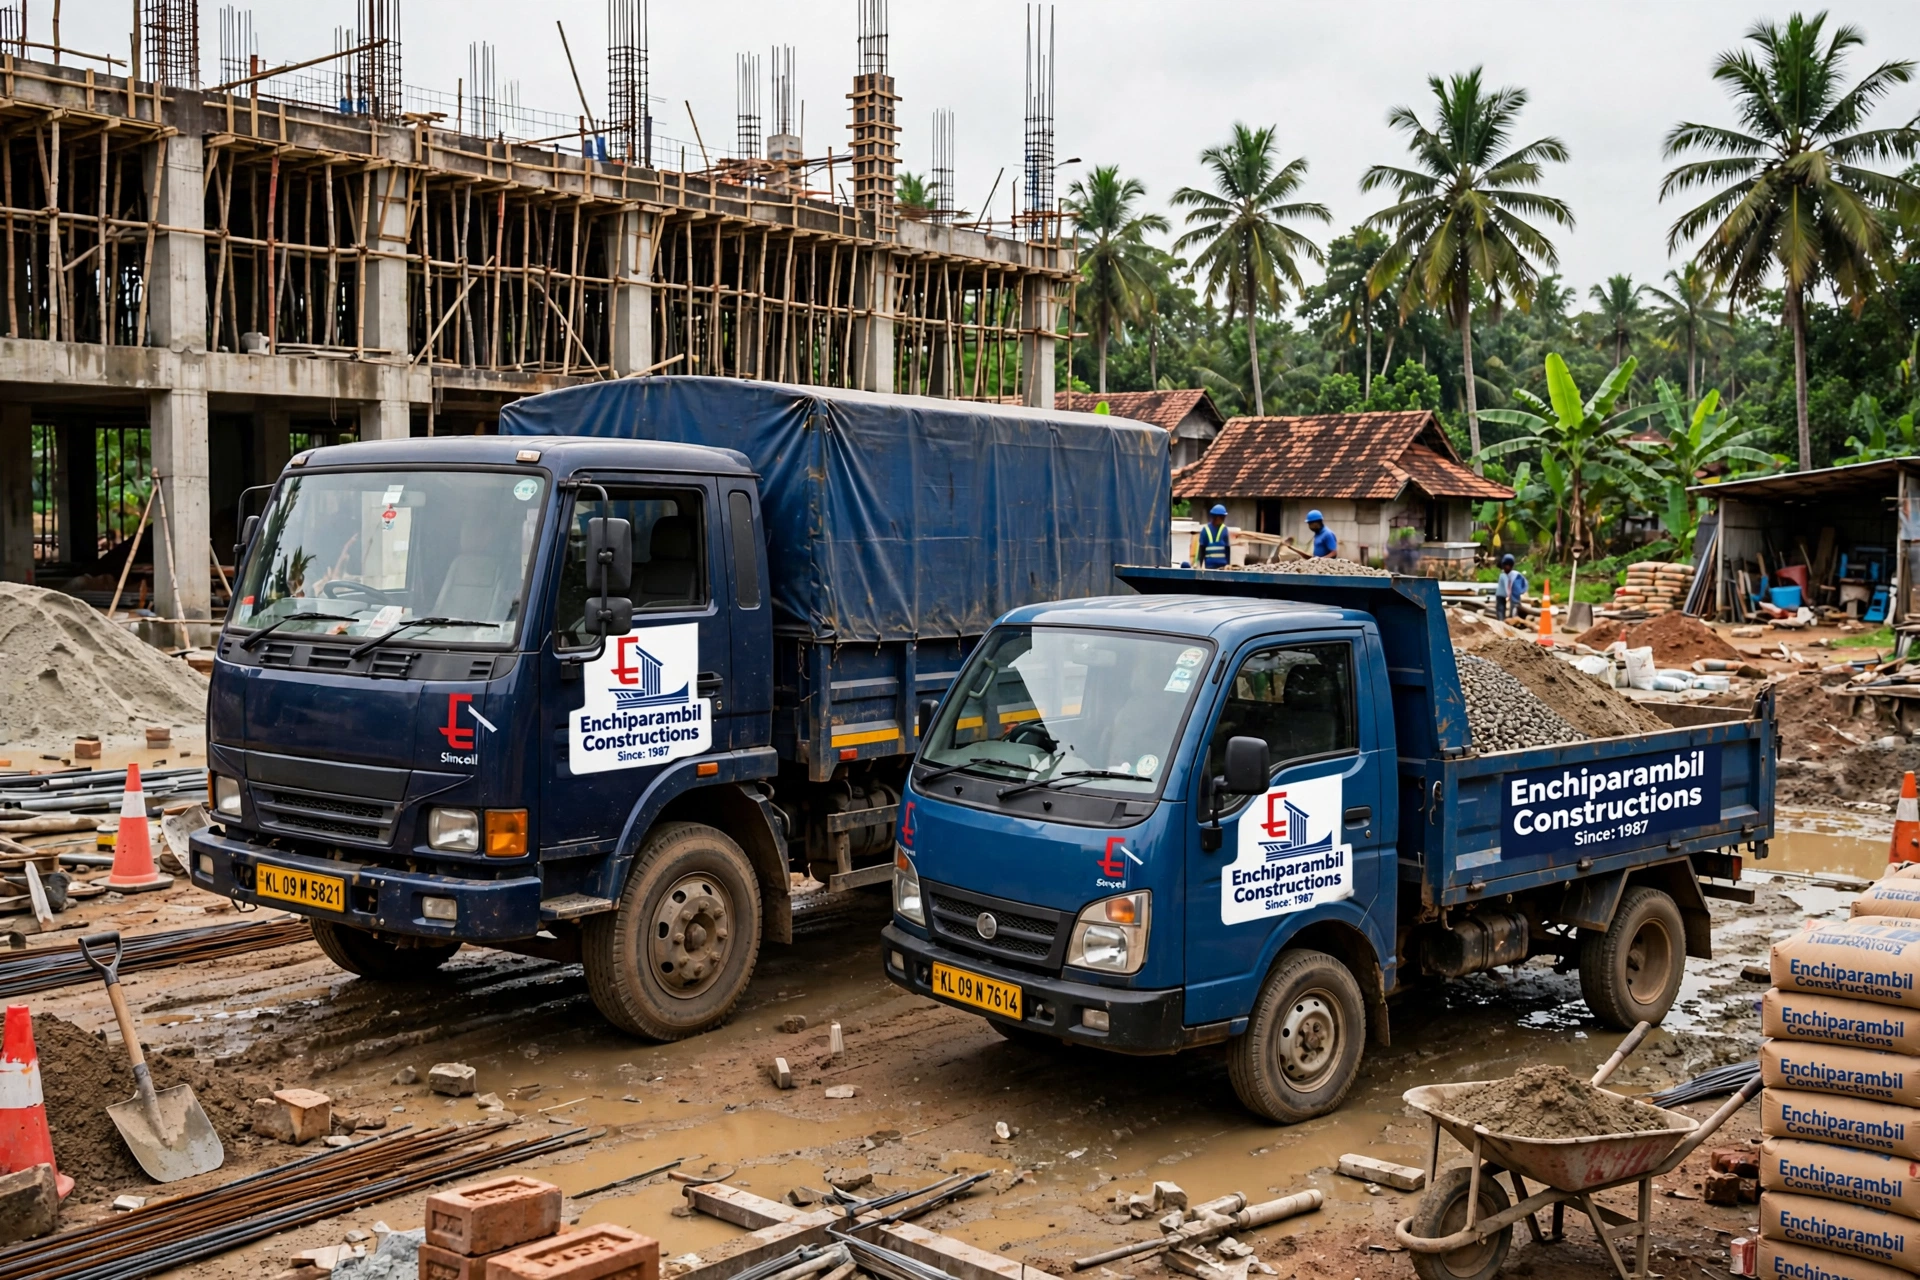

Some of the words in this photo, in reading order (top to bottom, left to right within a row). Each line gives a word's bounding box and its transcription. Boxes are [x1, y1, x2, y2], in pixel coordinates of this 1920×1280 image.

[580, 704, 701, 733] Enchiparambil
[583, 727, 699, 751] Constructions
[617, 750, 645, 761] Since:
[648, 746, 670, 757] 1987
[1511, 750, 1704, 806] Enchiparambil
[1513, 787, 1703, 836] Constructions
[1574, 829, 1616, 846] Since:
[1617, 819, 1649, 838] 1987
[1232, 851, 1344, 886] Enchiparambil
[265, 871, 279, 893] KL
[283, 875, 297, 896] 09
[311, 880, 340, 905] 5821
[1234, 873, 1342, 903] Constructions
[1265, 898, 1292, 910] Since:
[1294, 892, 1314, 905] 1987
[1790, 958, 1913, 990] Enchiparambil
[1795, 976, 1903, 999] Constructions
[941, 970, 955, 994] KL
[958, 976, 972, 998] 09
[976, 981, 983, 1002] N
[987, 984, 1018, 1013] 7614
[1782, 1007, 1904, 1038] Enchiparambil
[1787, 1024, 1893, 1047] Constructions
[1780, 1058, 1903, 1089] Enchiparambil
[1786, 1075, 1893, 1098] Constructions
[1782, 1104, 1904, 1140] Enchiparambil
[1786, 1122, 1894, 1149] Constructions
[1779, 1159, 1902, 1198] Enchiparambil
[1784, 1177, 1892, 1207] Constructions
[1780, 1210, 1904, 1252] Enchiparambil
[1784, 1228, 1893, 1260] Constructions
